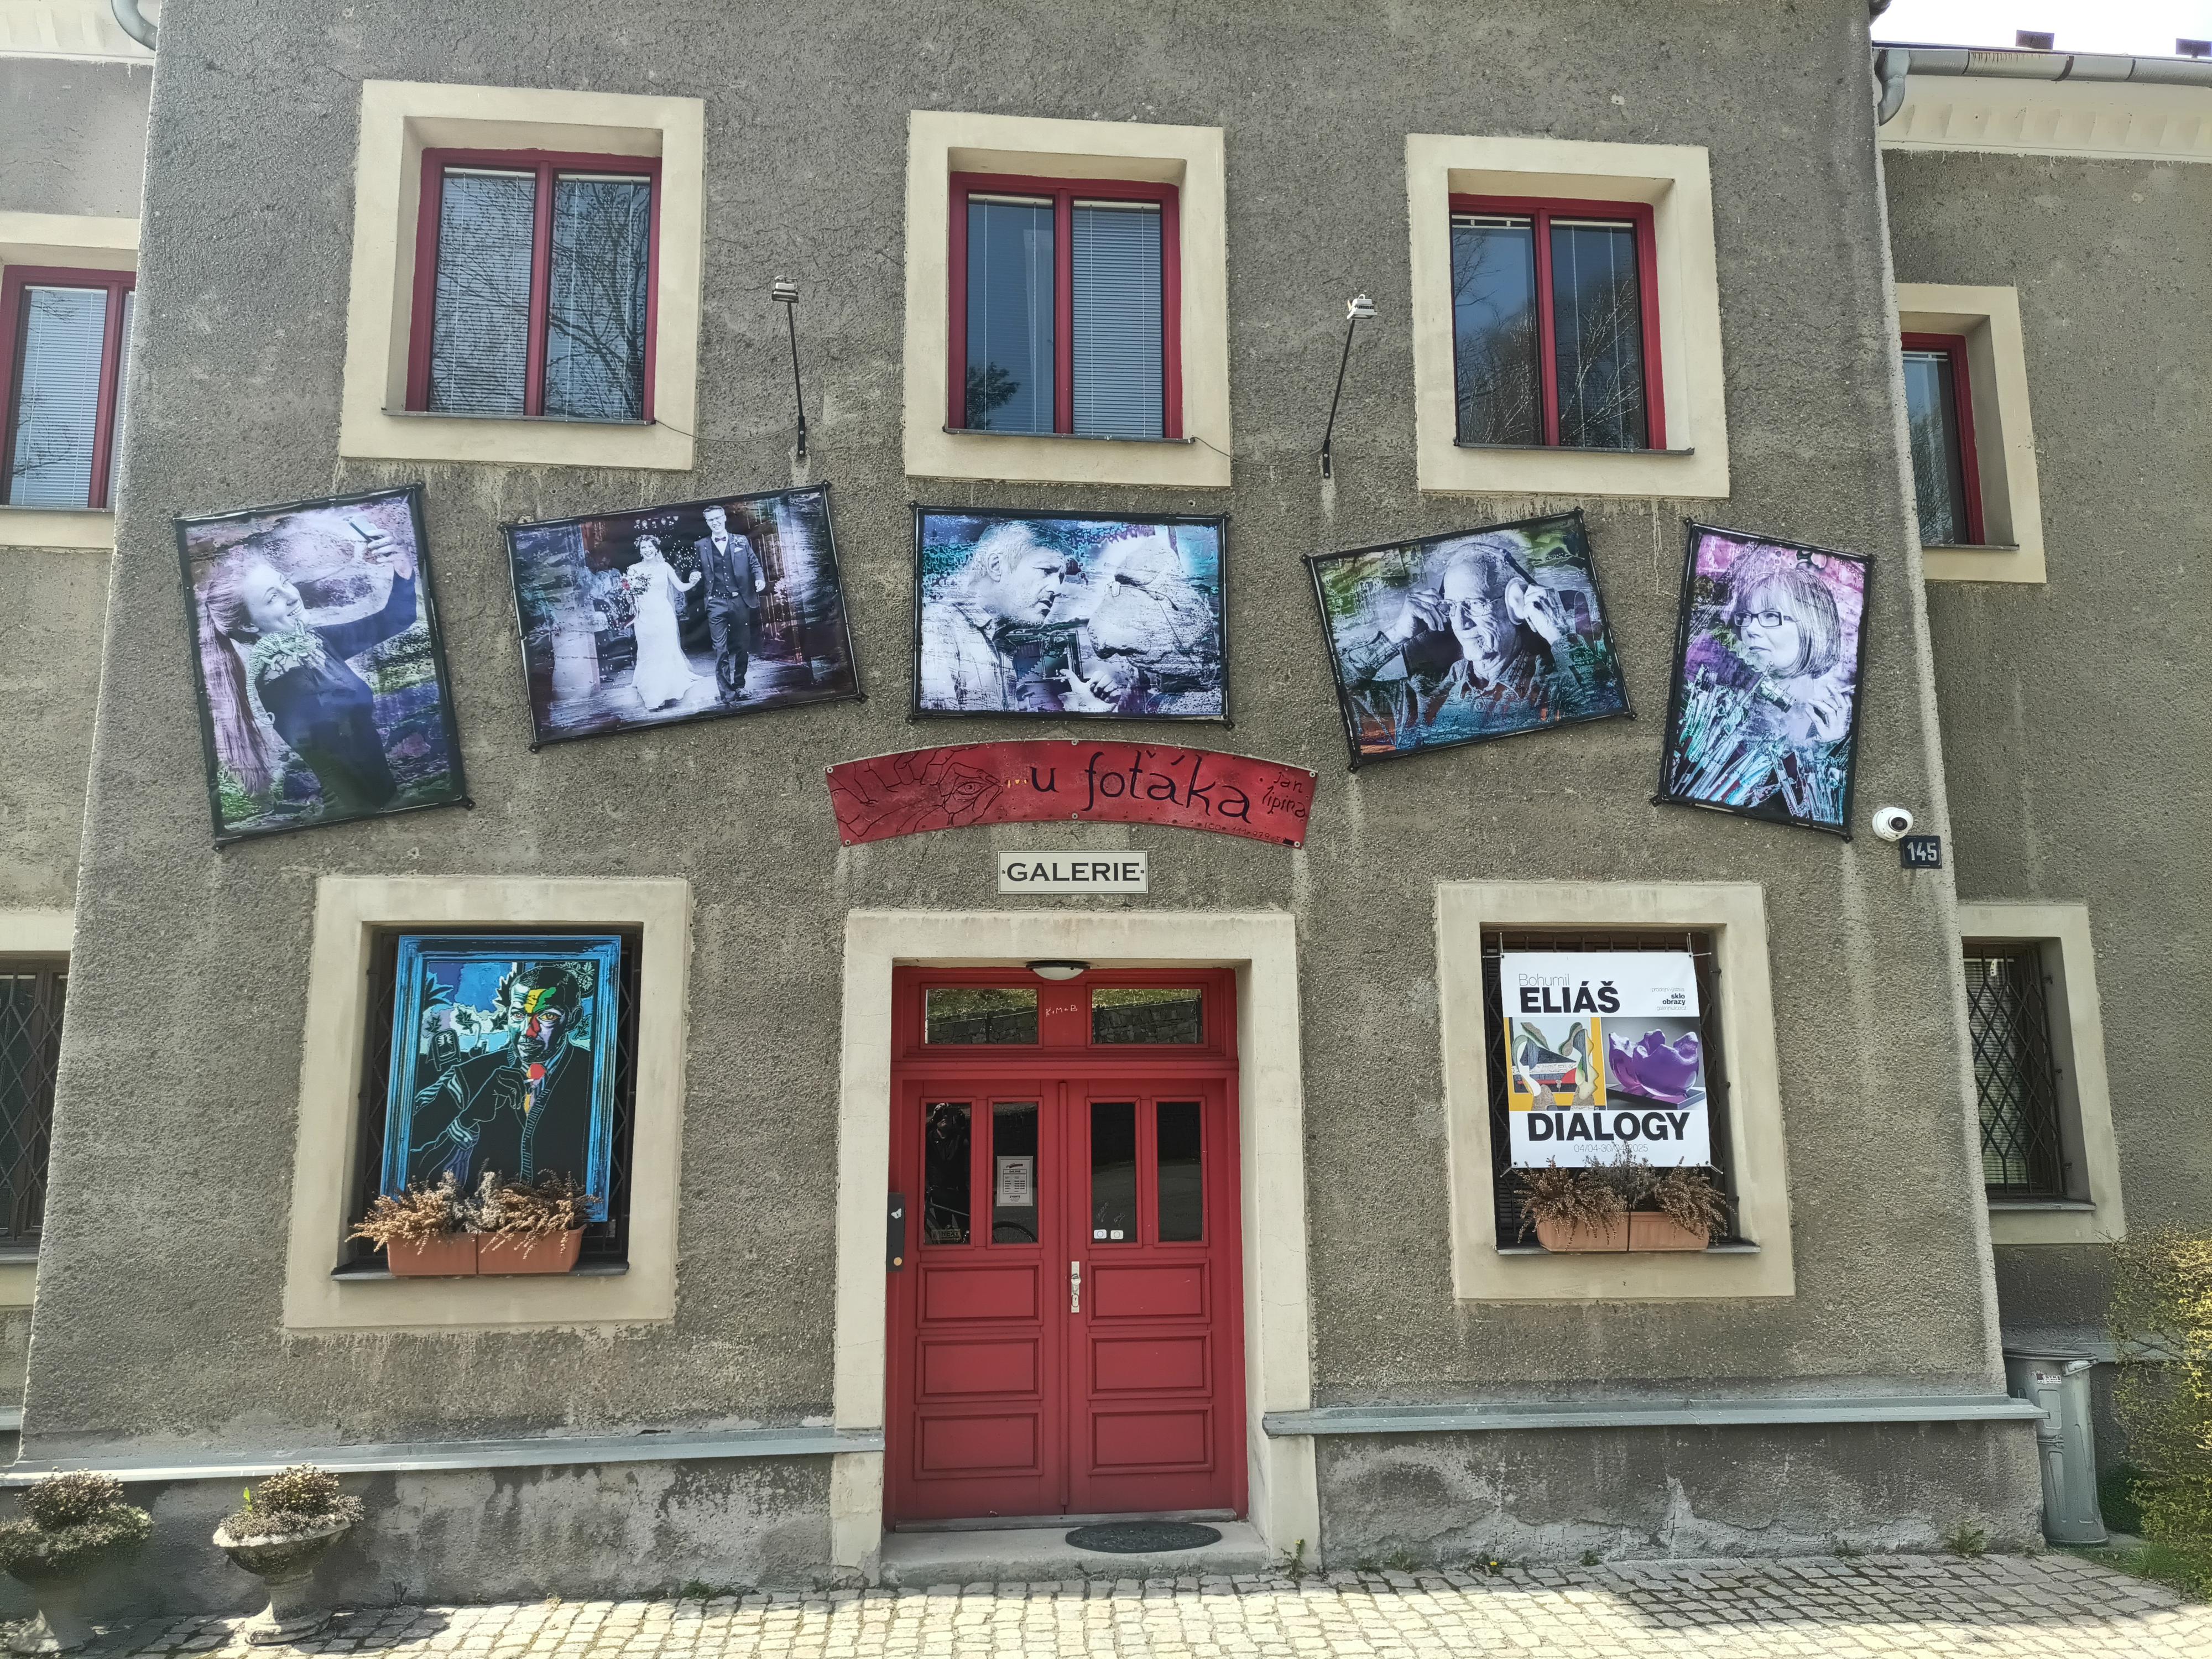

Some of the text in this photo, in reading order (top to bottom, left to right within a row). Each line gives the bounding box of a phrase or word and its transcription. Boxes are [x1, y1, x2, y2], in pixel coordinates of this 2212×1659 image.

[1029, 766, 1060, 793] u
[1907, 842, 1937, 861] 145
[1006, 862, 1140, 882] GALERIE
[1519, 973, 1570, 987] Bohumil
[1520, 980, 1620, 1014] ELIÁŠ
[1527, 1112, 1691, 1141] DIALOGY
